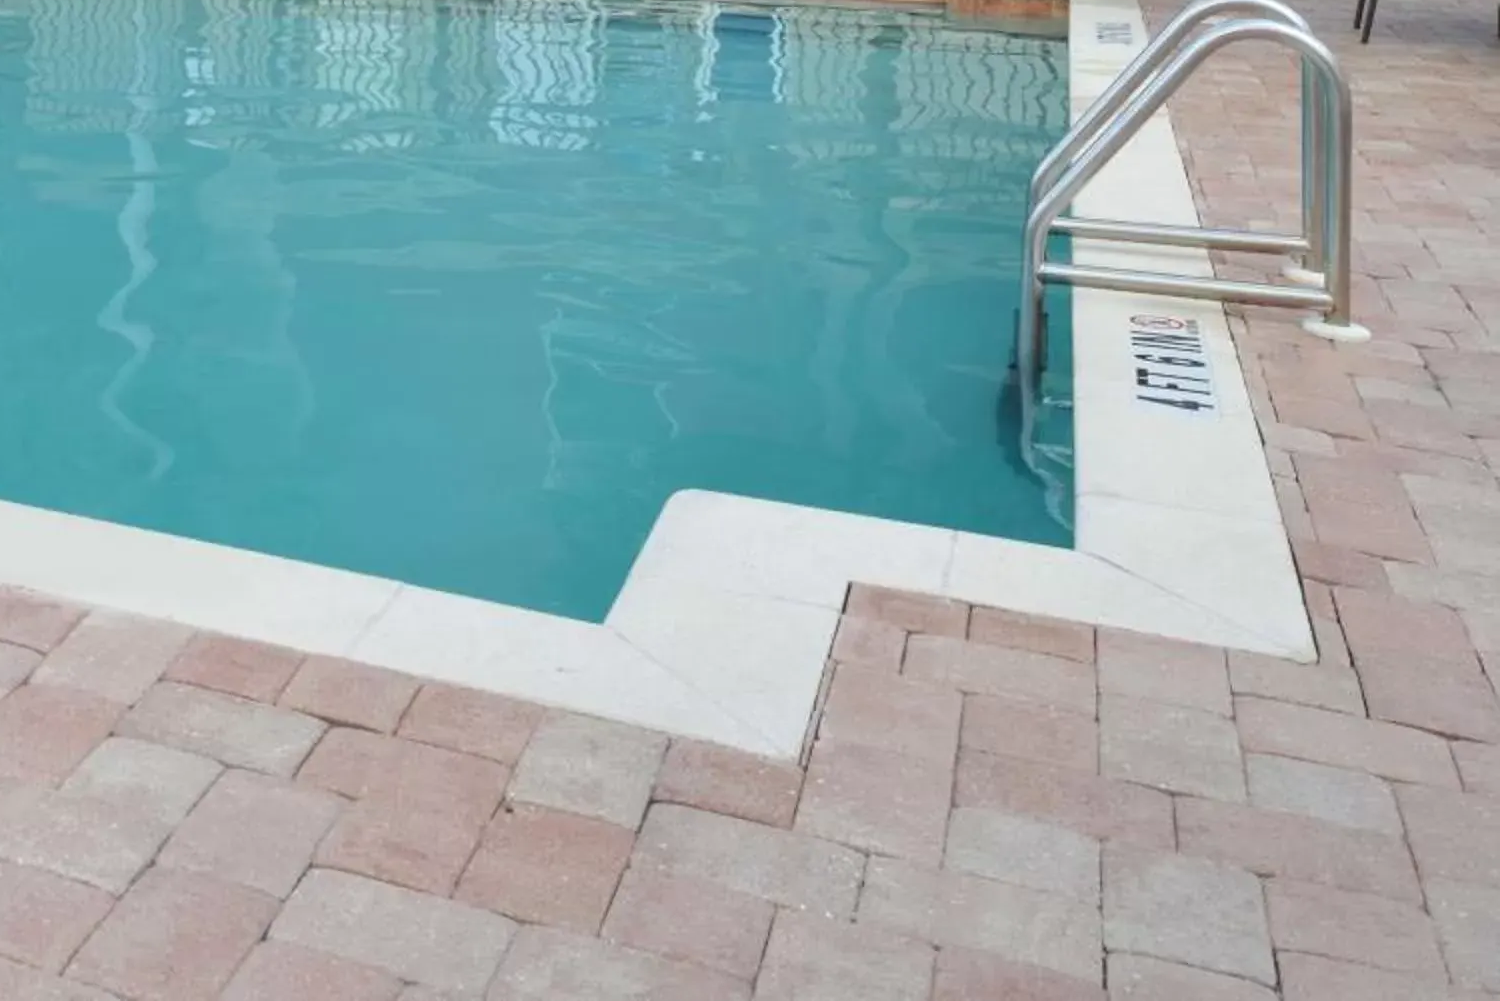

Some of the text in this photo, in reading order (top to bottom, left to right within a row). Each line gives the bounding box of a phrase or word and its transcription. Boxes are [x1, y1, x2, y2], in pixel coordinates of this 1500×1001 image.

[1129, 330, 1215, 411] 4 FT 6 IN
